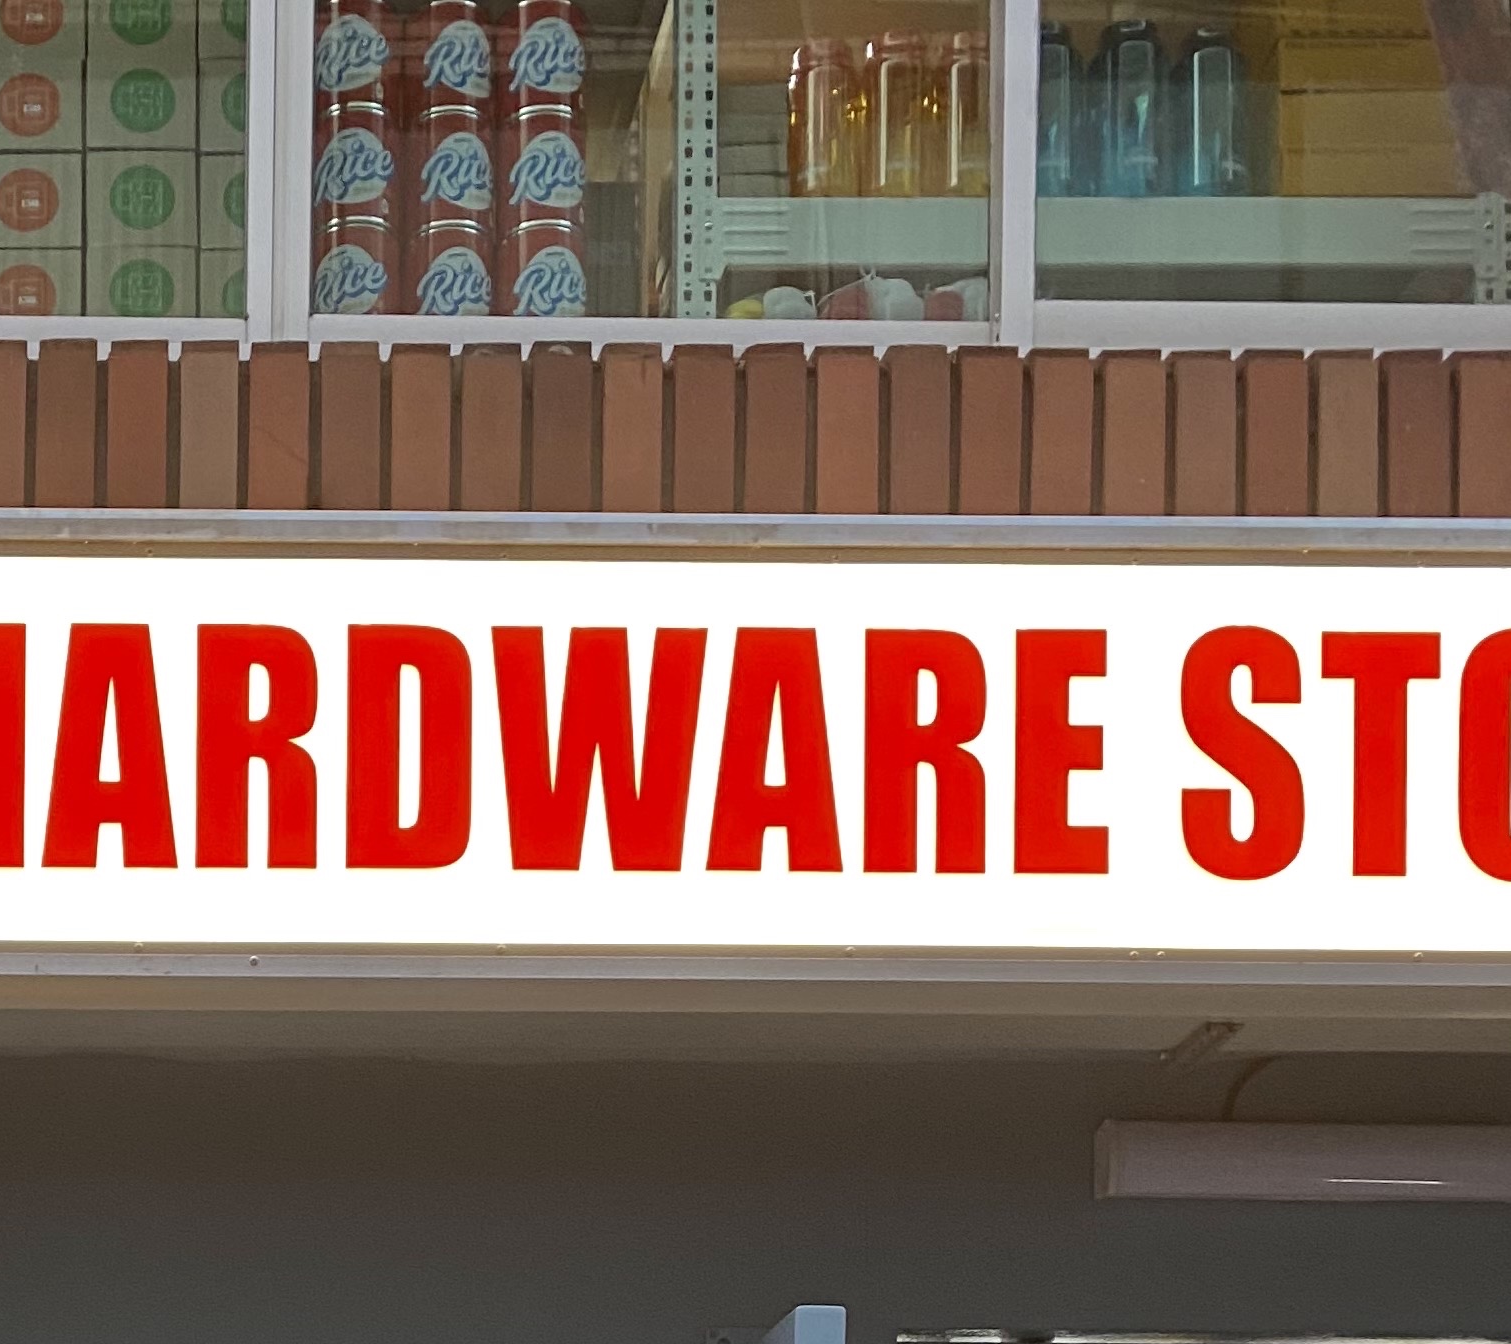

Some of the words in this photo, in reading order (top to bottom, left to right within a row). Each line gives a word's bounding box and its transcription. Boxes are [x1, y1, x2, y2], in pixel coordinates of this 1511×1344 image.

[317, 26, 389, 88] Rice
[423, 34, 489, 89] Ric
[314, 139, 395, 207] Rice
